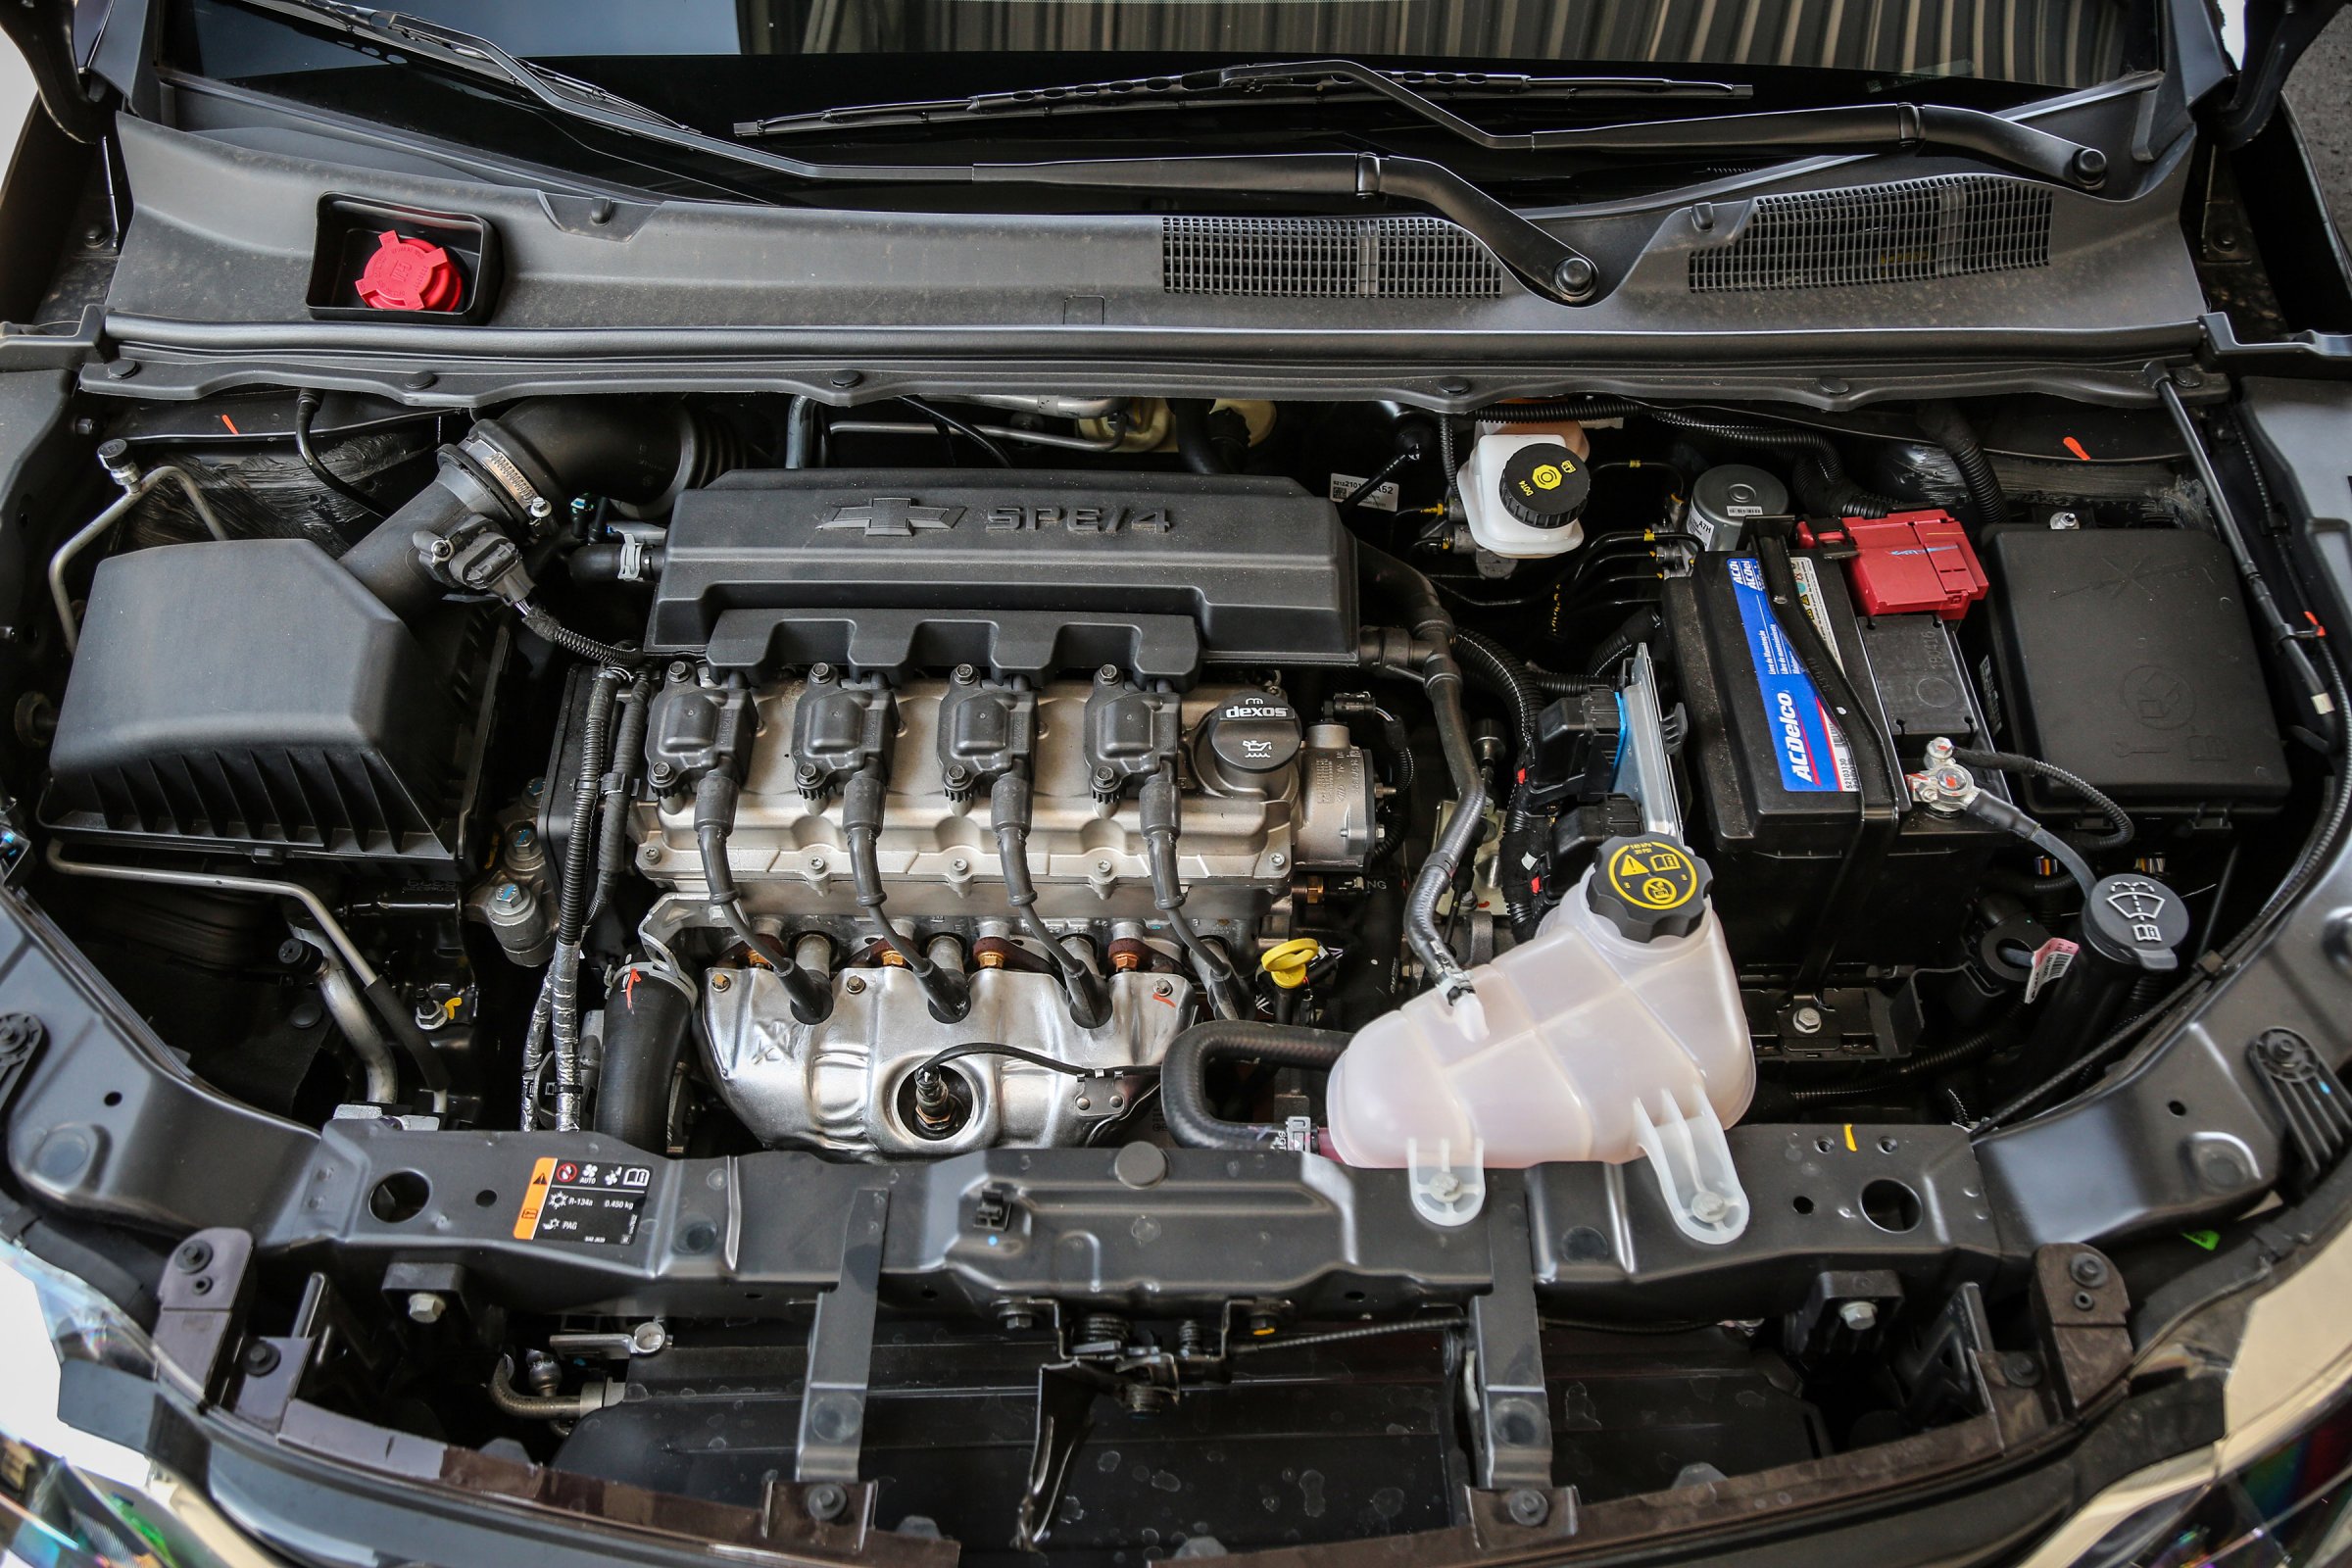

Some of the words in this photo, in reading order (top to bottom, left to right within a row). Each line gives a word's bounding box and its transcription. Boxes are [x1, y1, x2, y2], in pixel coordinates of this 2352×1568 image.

[1518, 480, 1534, 497] DOT4
[986, 507, 1171, 534] SPE/4
[1698, 520, 1712, 534] A7H
[1780, 663, 1788, 673] Libre
[1226, 706, 1287, 718] dexos
[1778, 692, 1813, 782] ACDelco
[1839, 759, 1853, 789] 52103130
[568, 1198, 593, 1206] R-134a
[605, 1199, 623, 1208] 0.450
[563, 1221, 577, 1230] PAG
